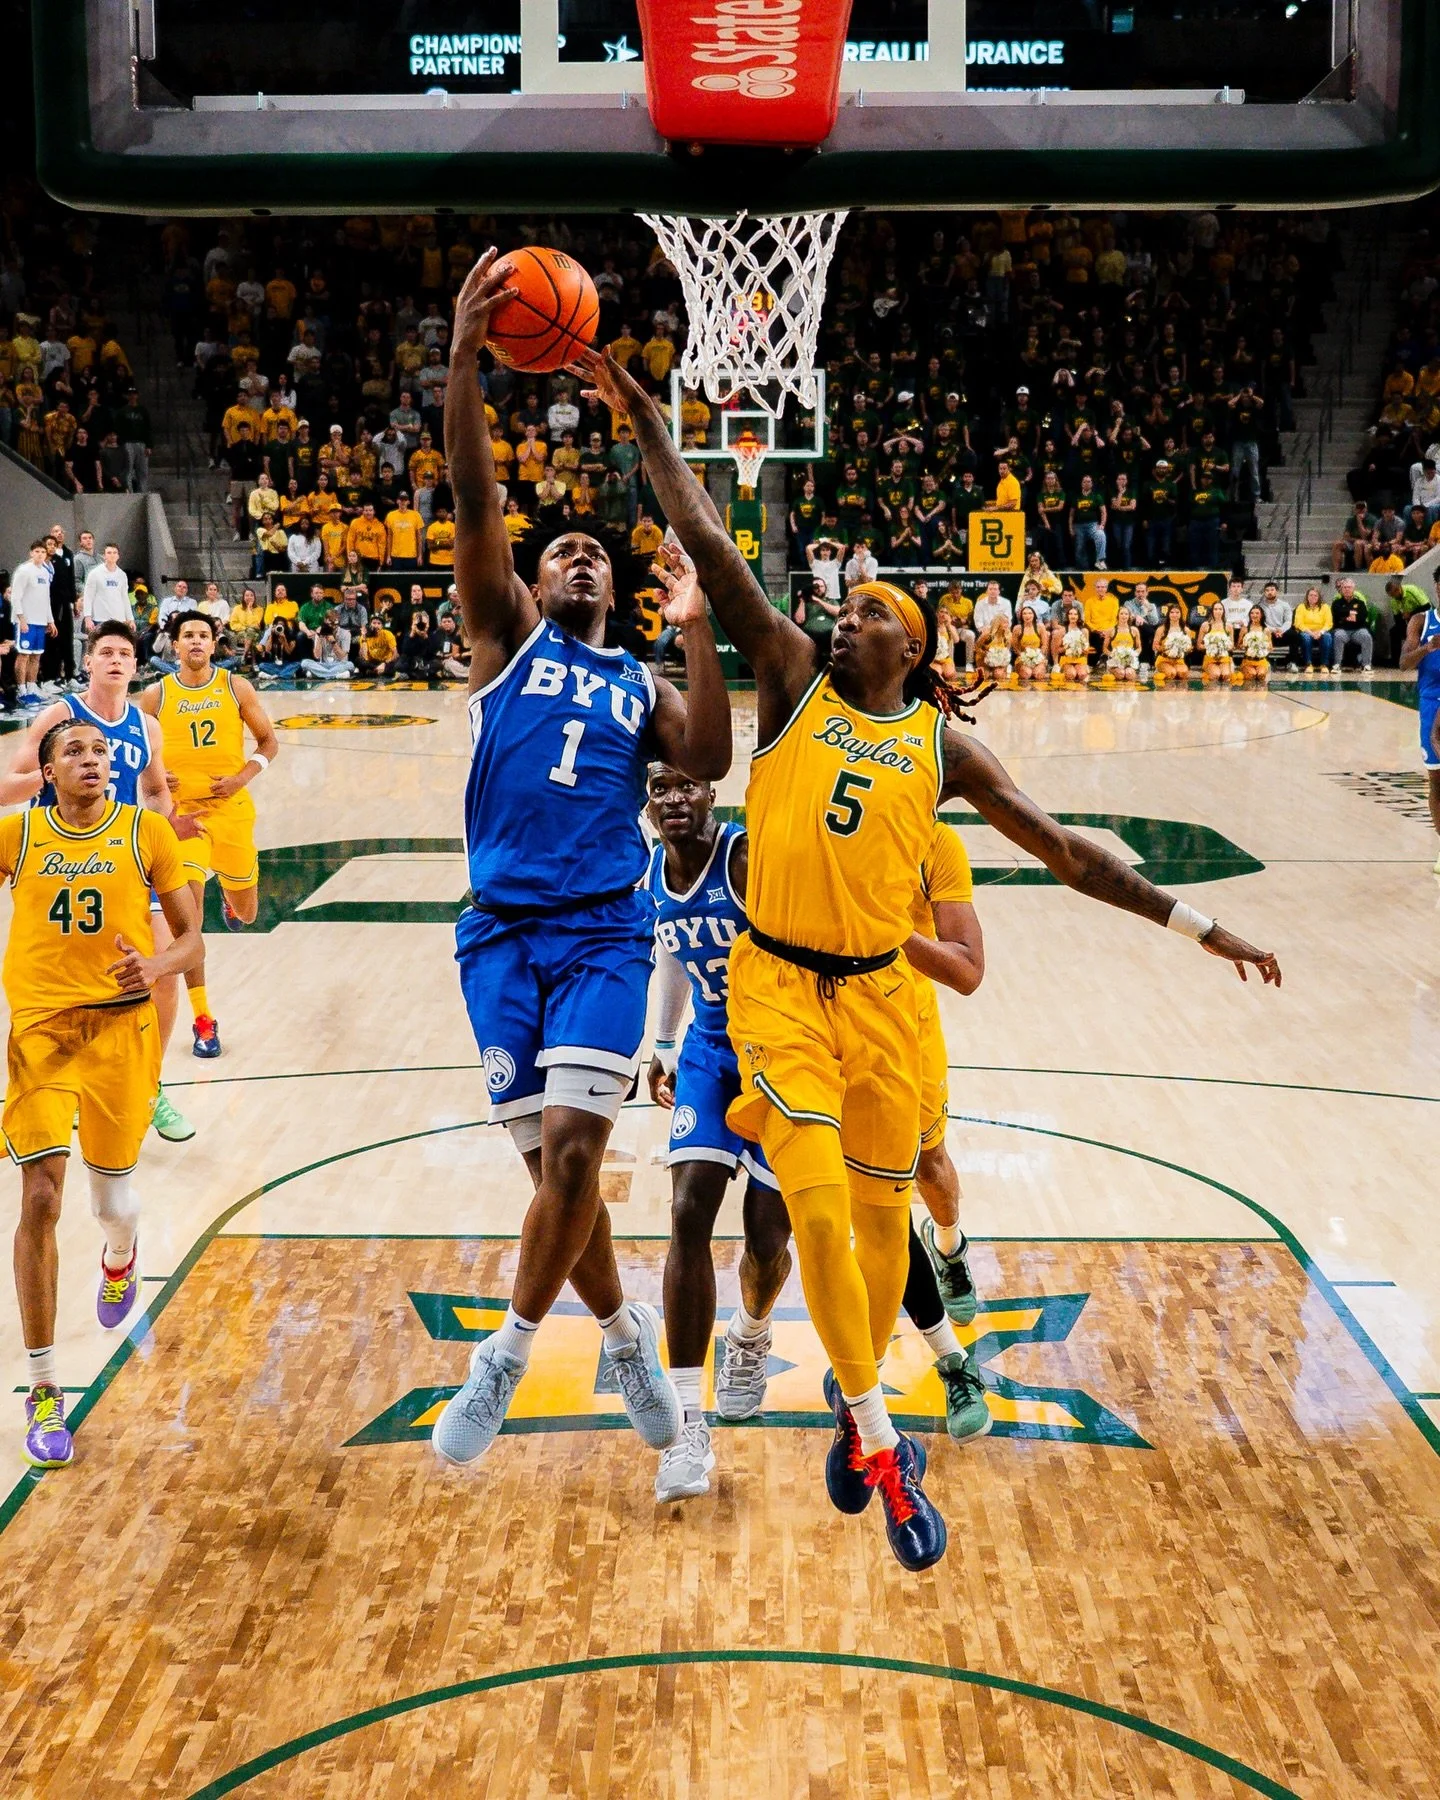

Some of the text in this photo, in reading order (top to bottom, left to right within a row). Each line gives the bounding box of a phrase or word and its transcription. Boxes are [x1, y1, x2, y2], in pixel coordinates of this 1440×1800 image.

[410, 56, 505, 76] PARTNER
[980, 518, 1014, 559] BU
[176, 696, 222, 715] Baylor
[520, 657, 645, 735] BYU
[189, 719, 217, 748] 12
[548, 719, 586, 787] 1
[812, 715, 915, 774] Baylor
[106, 738, 142, 770] YU
[824, 768, 875, 838] 5
[37, 852, 116, 883] Baylor
[48, 888, 104, 936] 43
[657, 916, 739, 953] BYU
